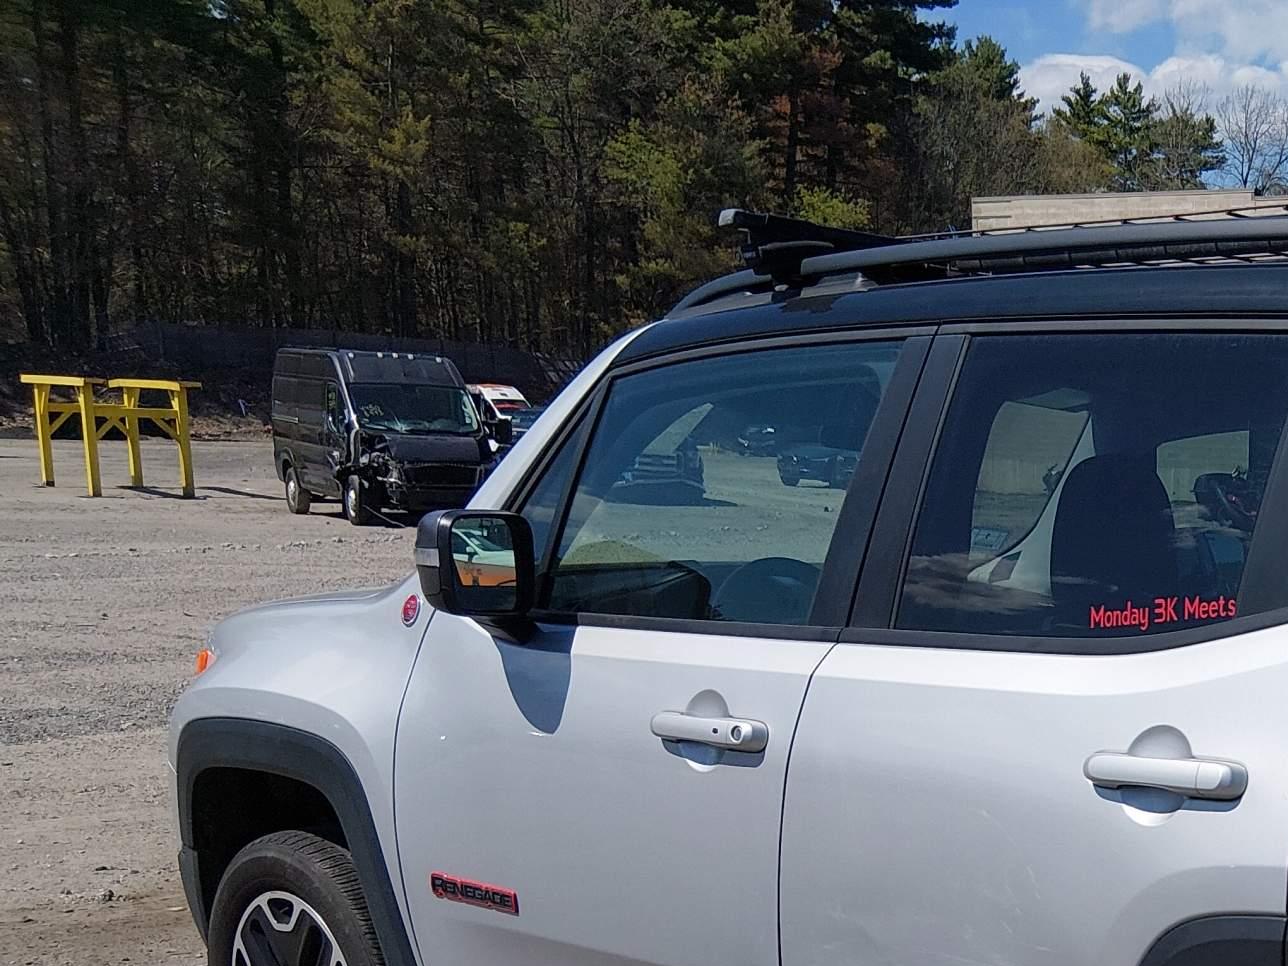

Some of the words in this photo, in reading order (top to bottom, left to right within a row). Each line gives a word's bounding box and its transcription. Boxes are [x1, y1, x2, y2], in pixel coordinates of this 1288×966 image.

[1088, 600, 1149, 631] Monday
[1153, 596, 1179, 623] 3K
[1183, 595, 1237, 621] Meets
[431, 875, 516, 911] RENEGADE
